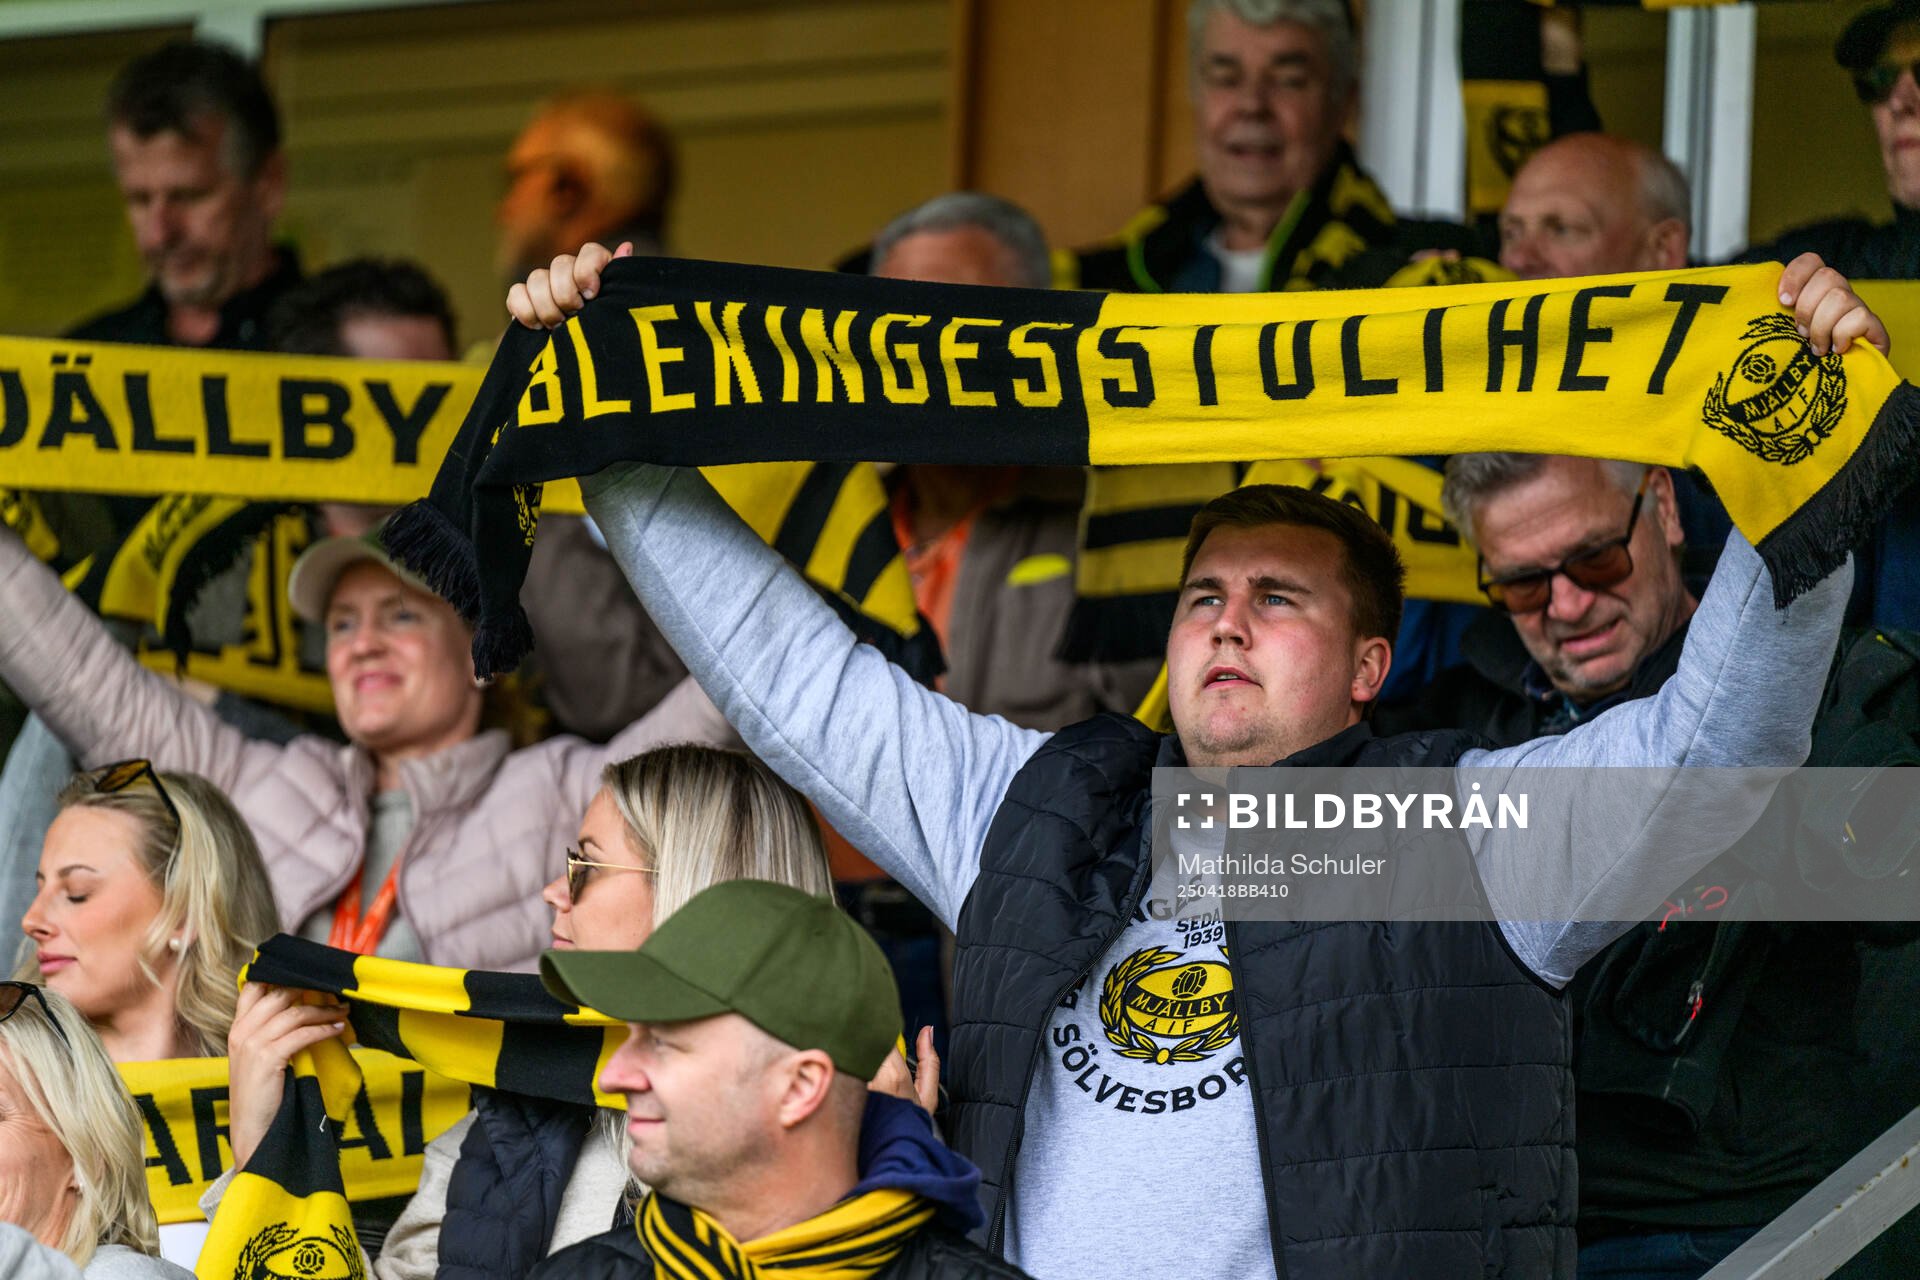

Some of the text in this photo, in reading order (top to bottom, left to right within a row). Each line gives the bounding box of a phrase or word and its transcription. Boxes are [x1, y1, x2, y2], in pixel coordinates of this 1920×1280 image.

[0, 354, 452, 465] JÄLLBY
[1742, 355, 1812, 421] MJÄLLBY
[1175, 907, 1223, 933] SEDA
[1183, 926, 1224, 949] 1939
[1129, 992, 1228, 1018] MJÄLLBY
[1053, 1023, 1249, 1115] SÖLVESBOR
